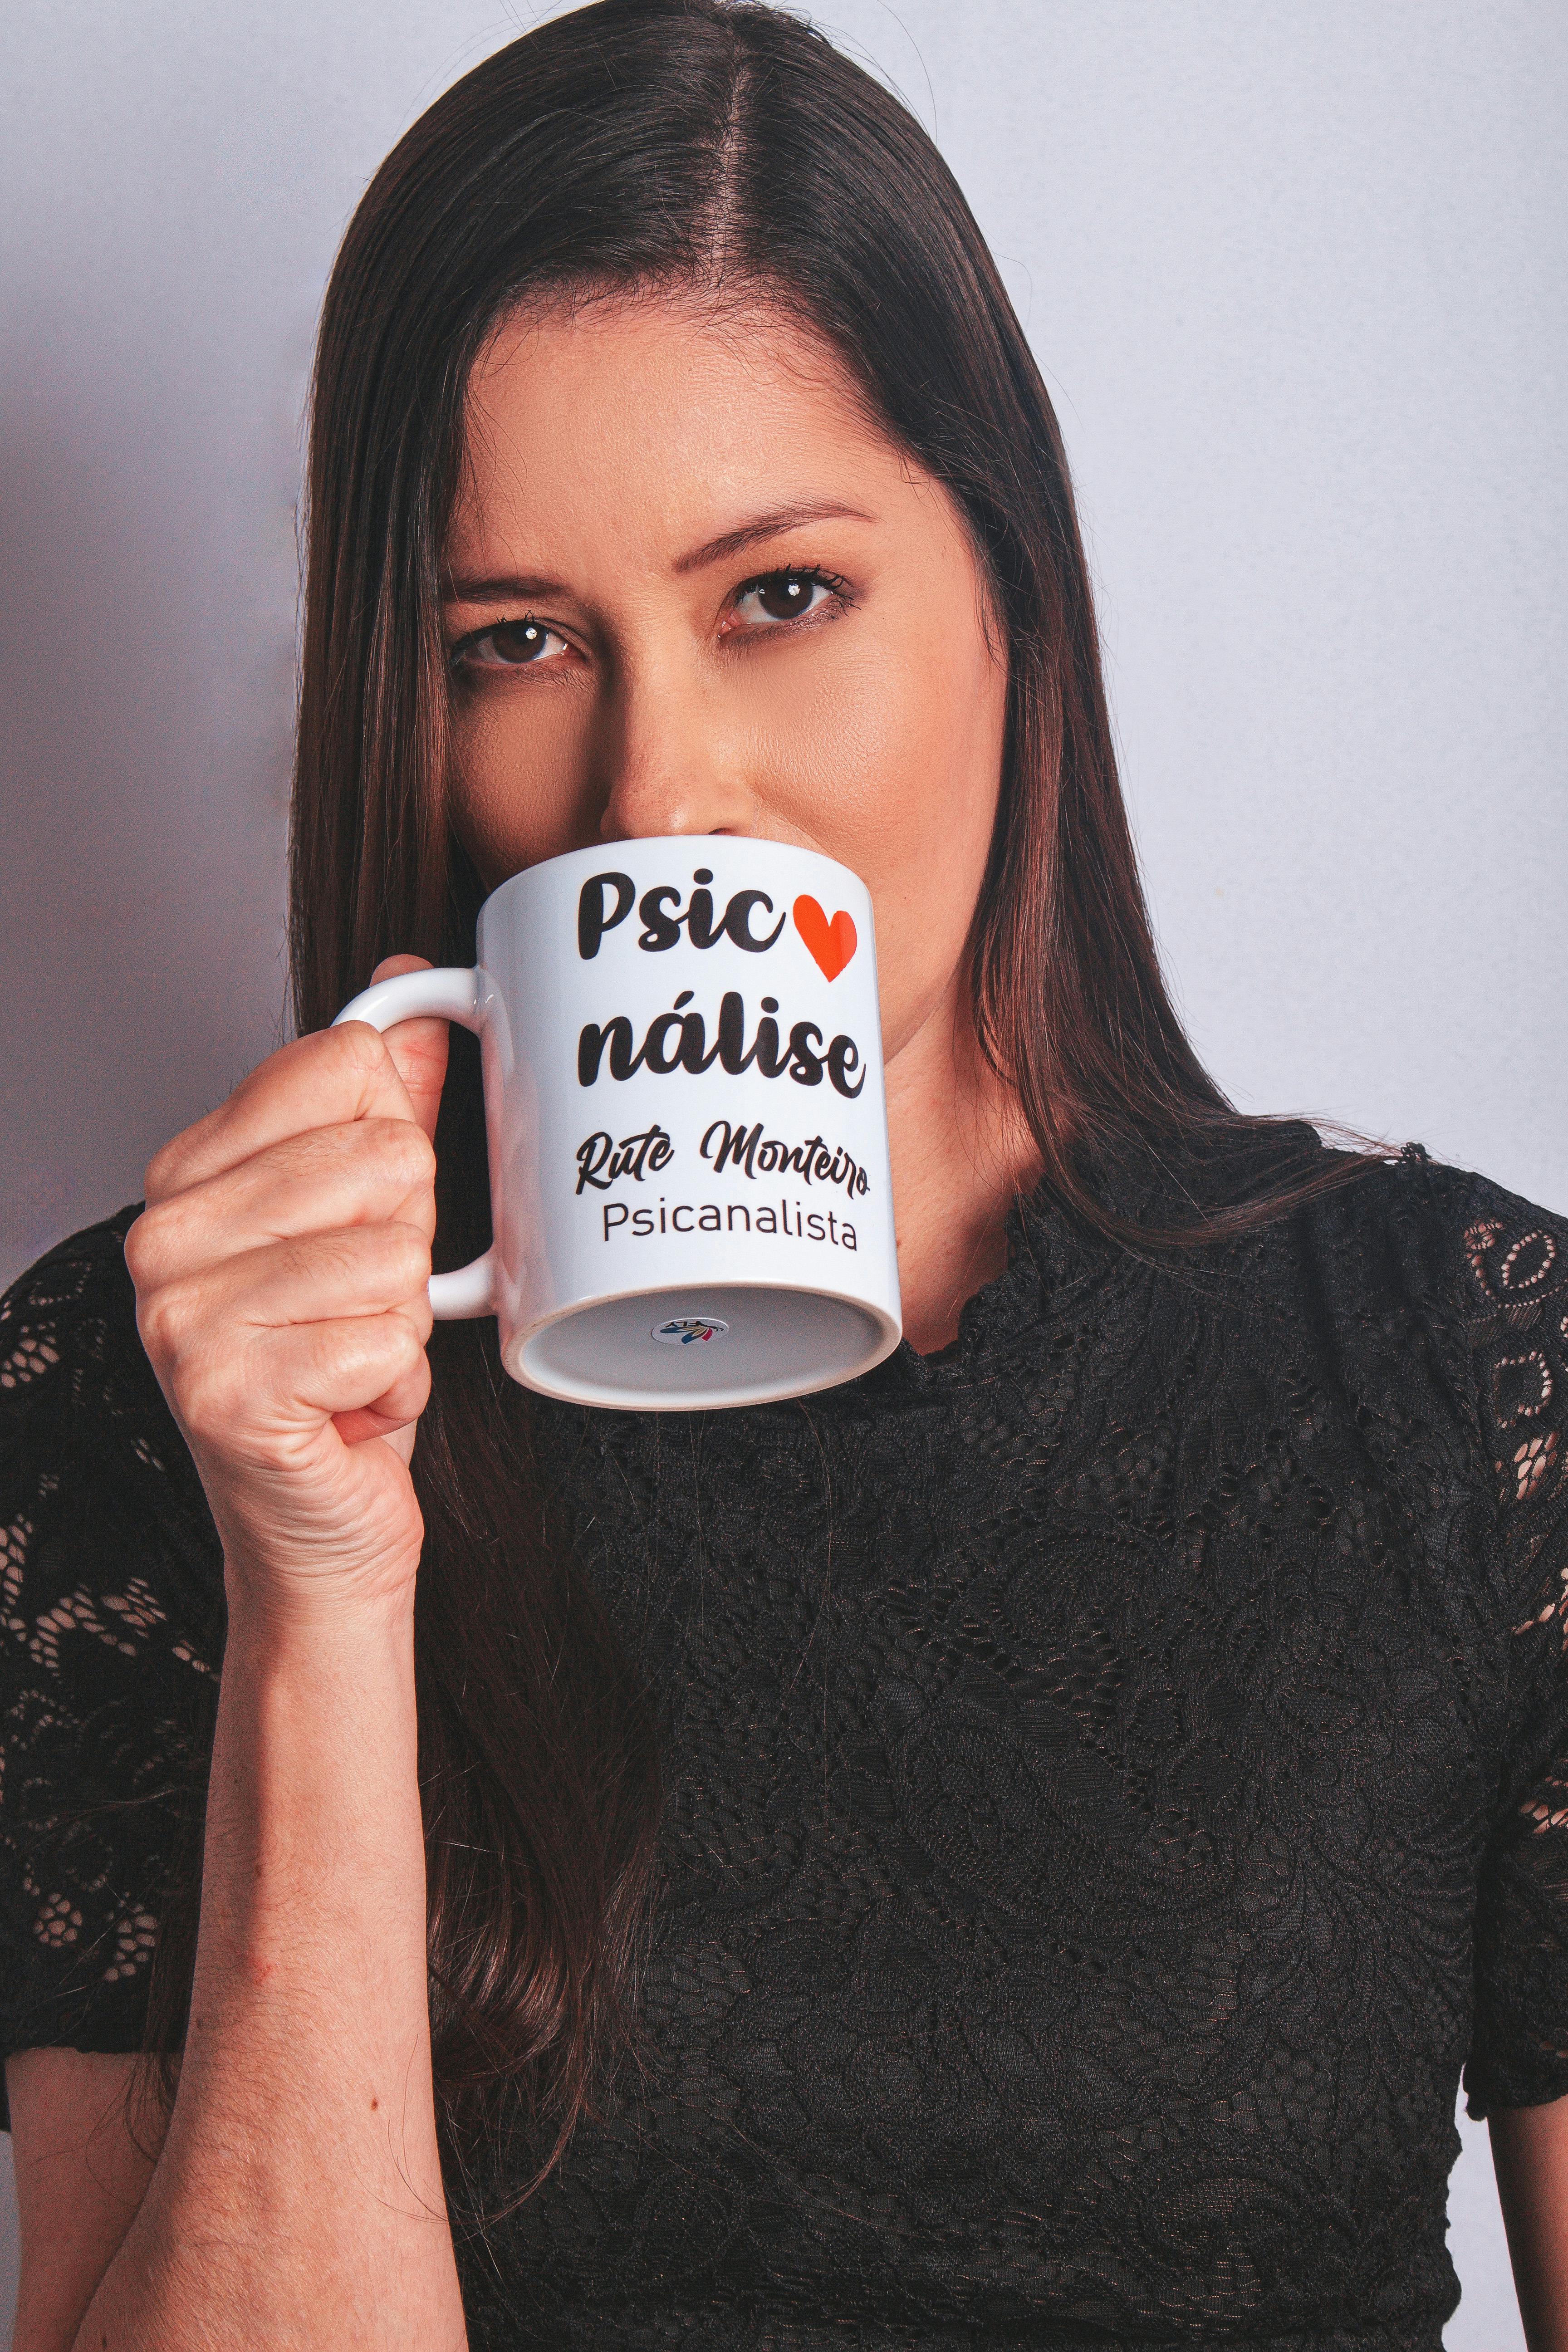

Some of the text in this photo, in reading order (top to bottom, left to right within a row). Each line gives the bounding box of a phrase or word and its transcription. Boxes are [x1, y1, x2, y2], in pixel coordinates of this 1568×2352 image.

[578, 868, 786, 960] Psic
[578, 991, 866, 1099] nálise
[575, 1120, 870, 1200] Rute Monteiro
[603, 1197, 857, 1251] Psicanalista
